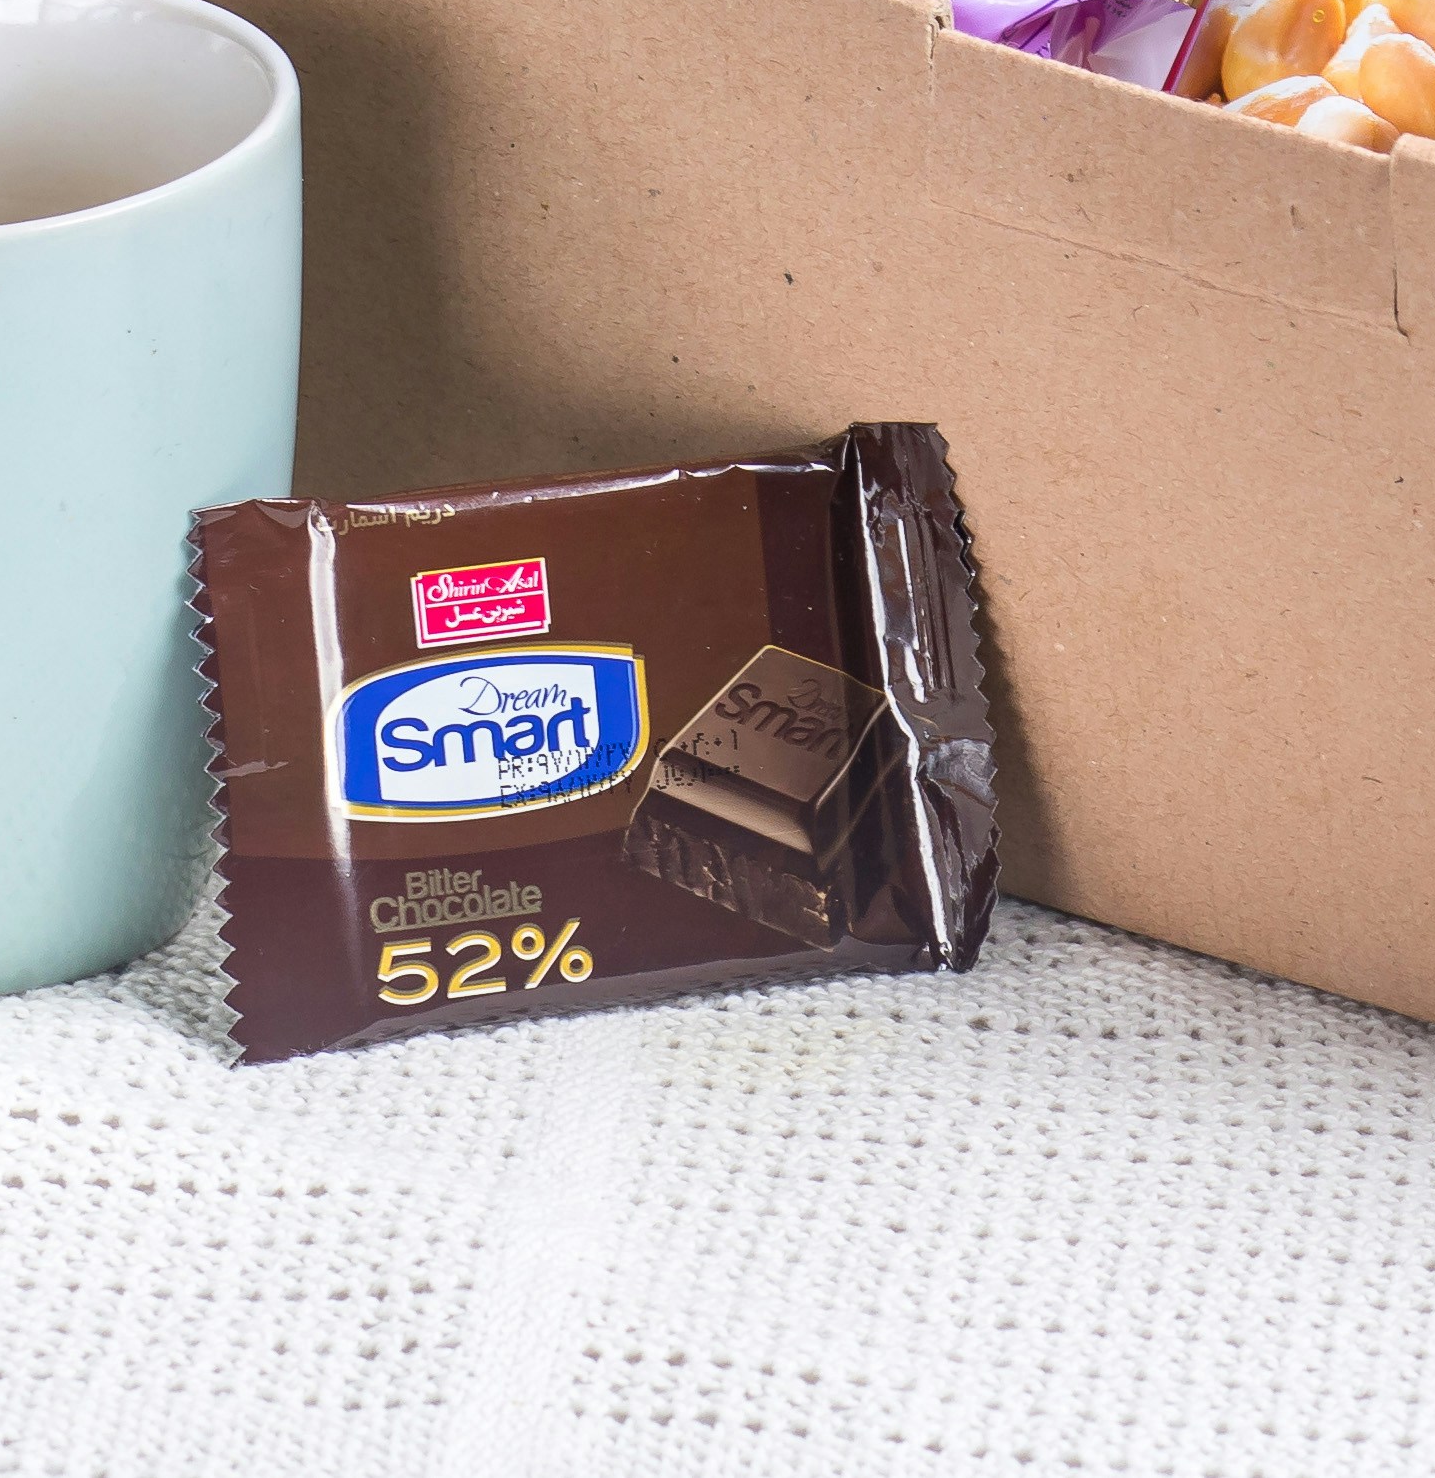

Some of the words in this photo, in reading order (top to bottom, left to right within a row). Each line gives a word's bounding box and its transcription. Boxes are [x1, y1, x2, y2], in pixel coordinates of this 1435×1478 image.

[427, 573, 487, 603] Shirin
[485, 566, 539, 594] Asal
[458, 675, 567, 716] Dream
[380, 696, 591, 772] Smart
[369, 880, 543, 930] Chocolate
[405, 867, 483, 900] Bitter
[377, 916, 594, 1006] 52%
